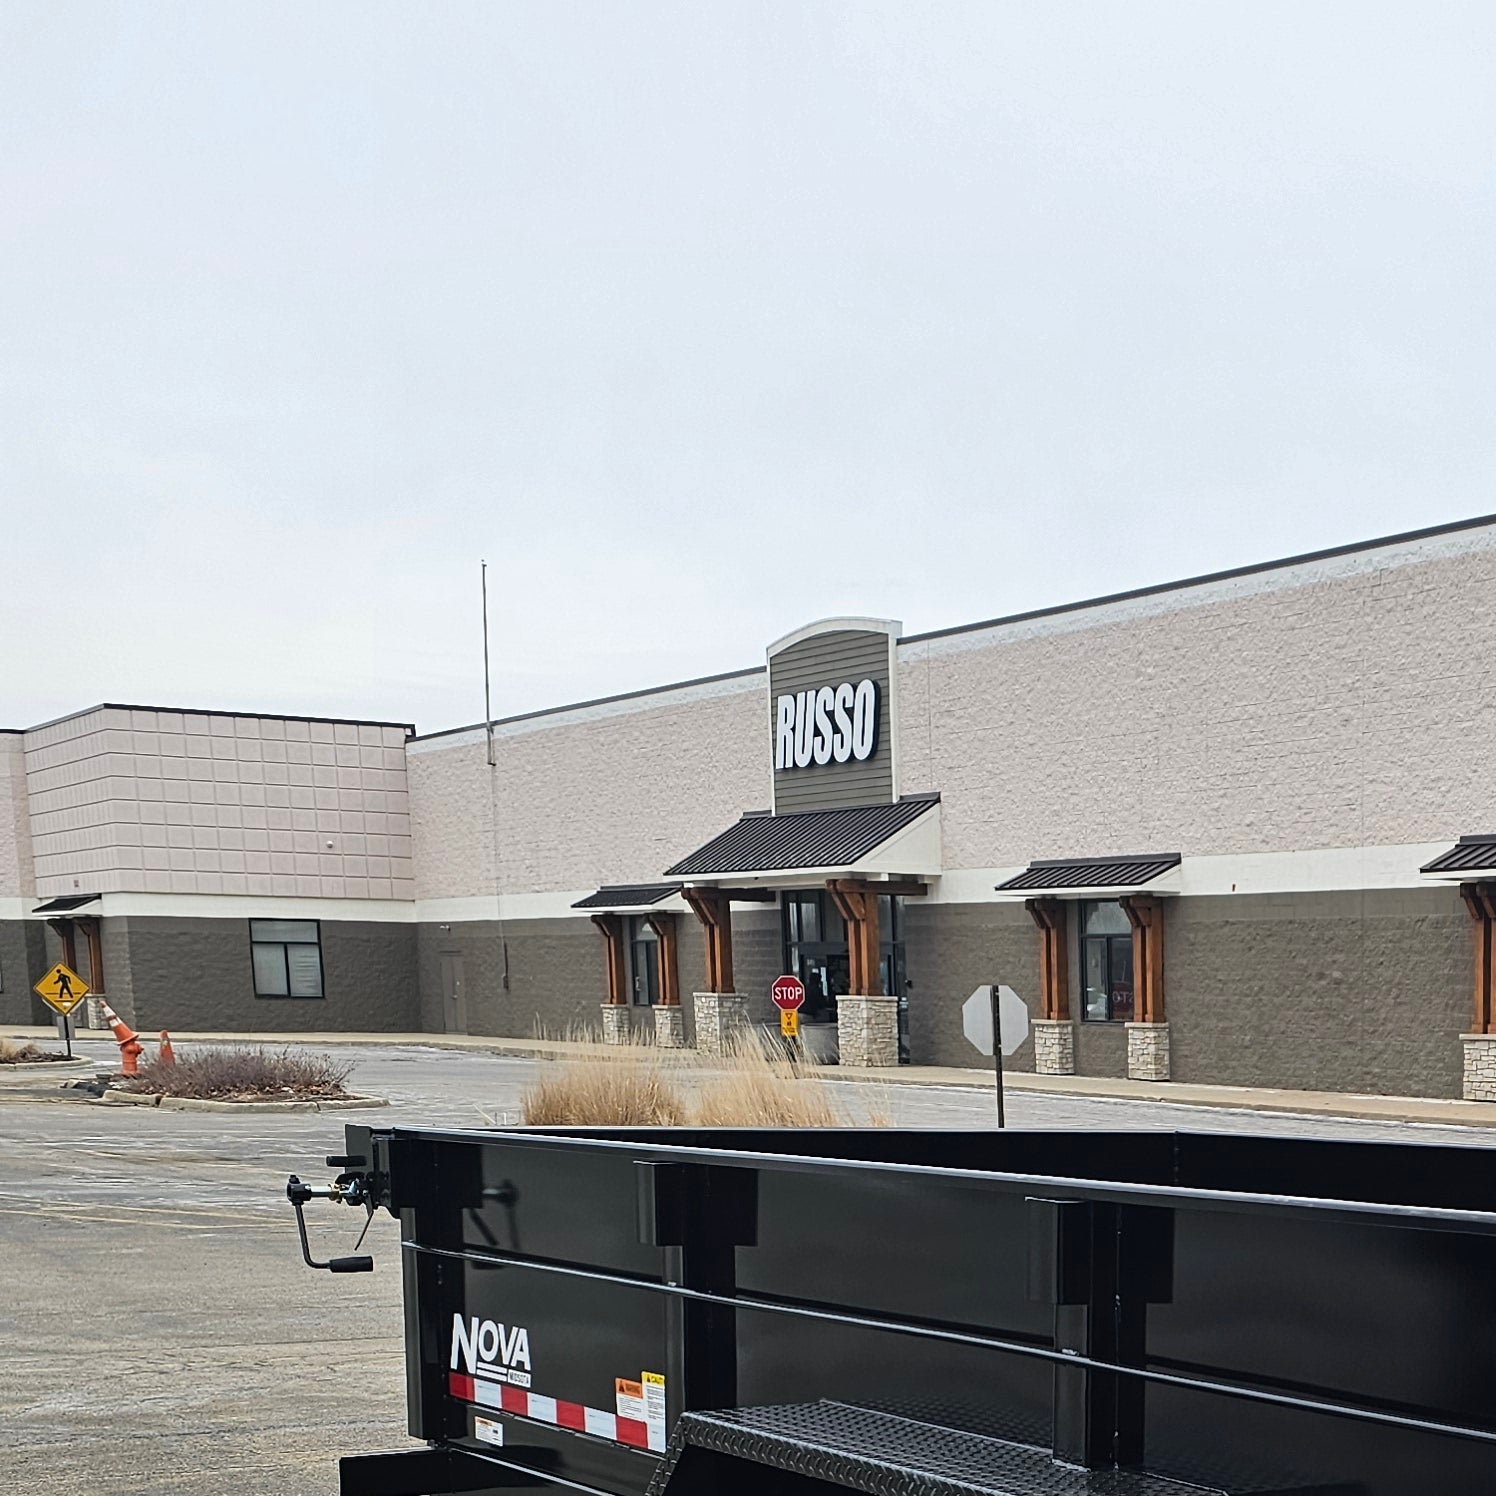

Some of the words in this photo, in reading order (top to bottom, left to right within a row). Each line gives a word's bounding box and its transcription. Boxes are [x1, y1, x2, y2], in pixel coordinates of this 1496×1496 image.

[776, 679, 876, 770] RUSSO
[774, 986, 803, 1000] STOP
[450, 1313, 531, 1374] NOVA
